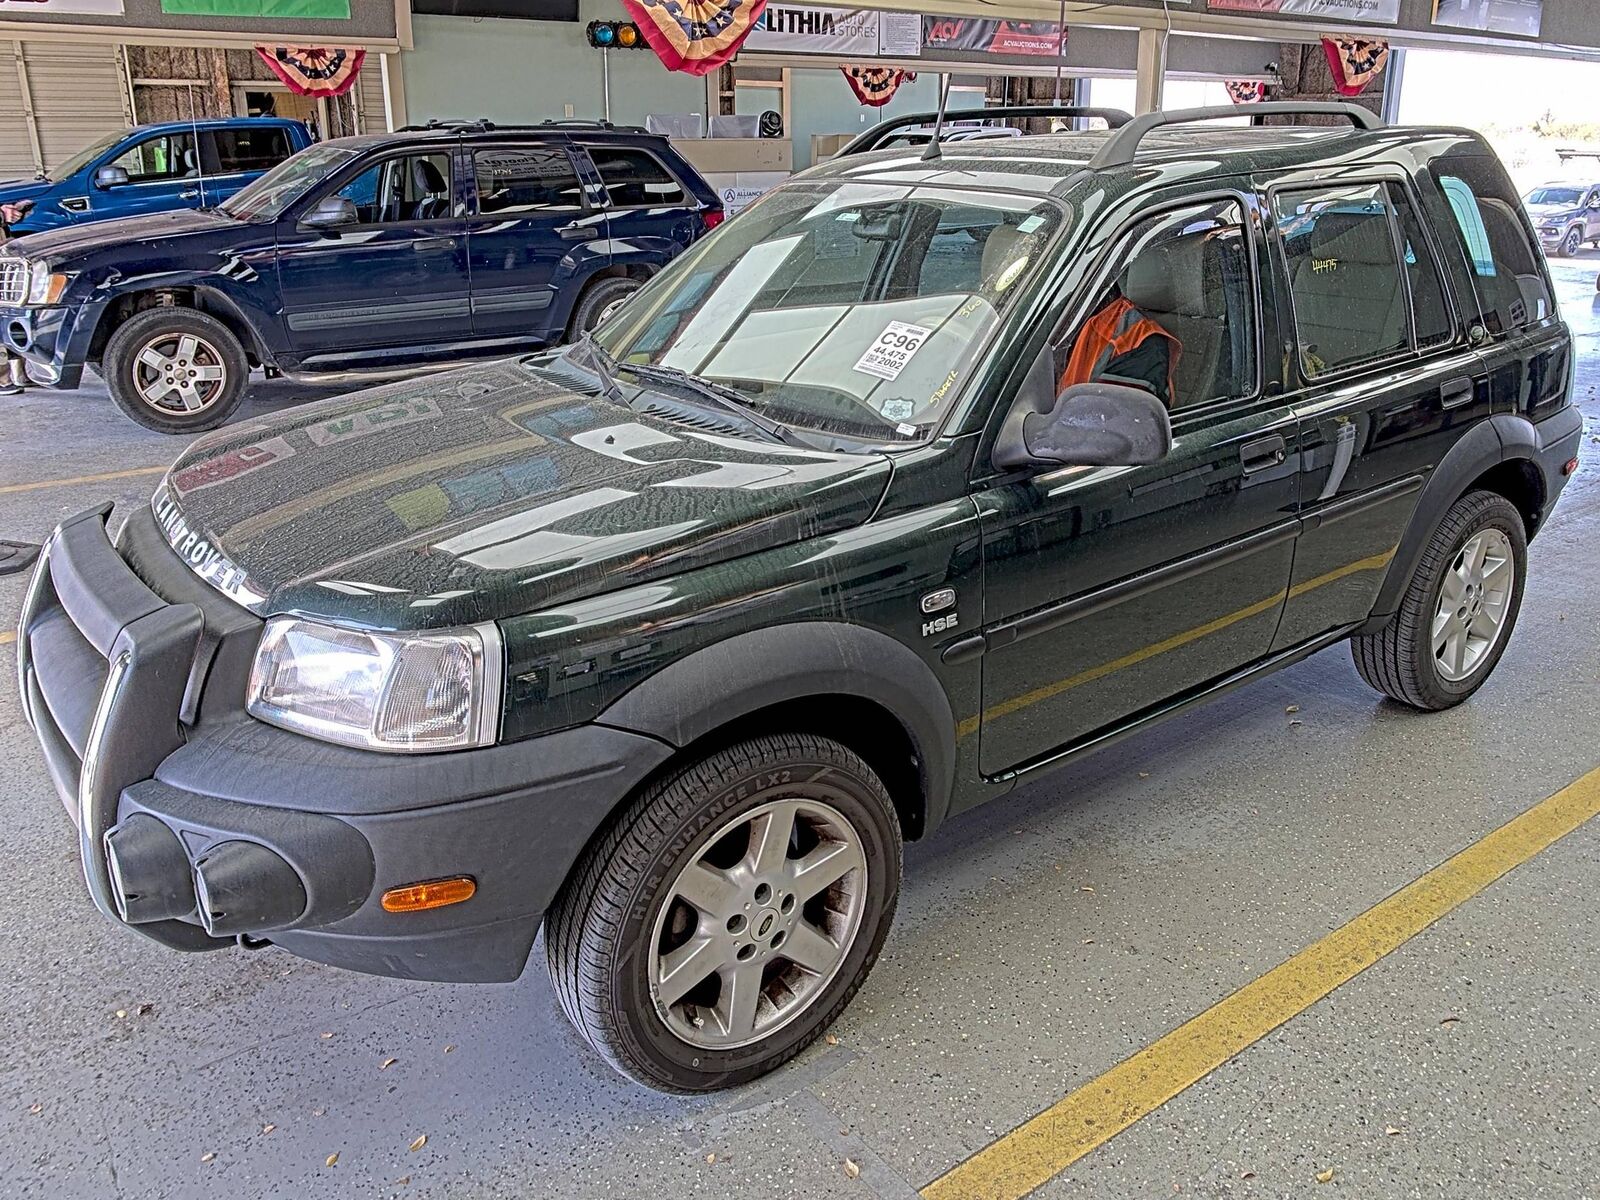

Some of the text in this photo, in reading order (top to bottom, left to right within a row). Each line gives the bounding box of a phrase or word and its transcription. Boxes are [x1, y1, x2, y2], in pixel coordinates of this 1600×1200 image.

[766, 8, 836, 36] LITHIA
[838, 13, 865, 26] AUTO
[838, 25, 877, 38] STORES
[881, 332, 920, 351] C96
[877, 357, 904, 370] 2002
[156, 492, 248, 595] LAND ROVER
[922, 613, 959, 637] HSE
[631, 770, 792, 921] HTR ENHANCE LX2
